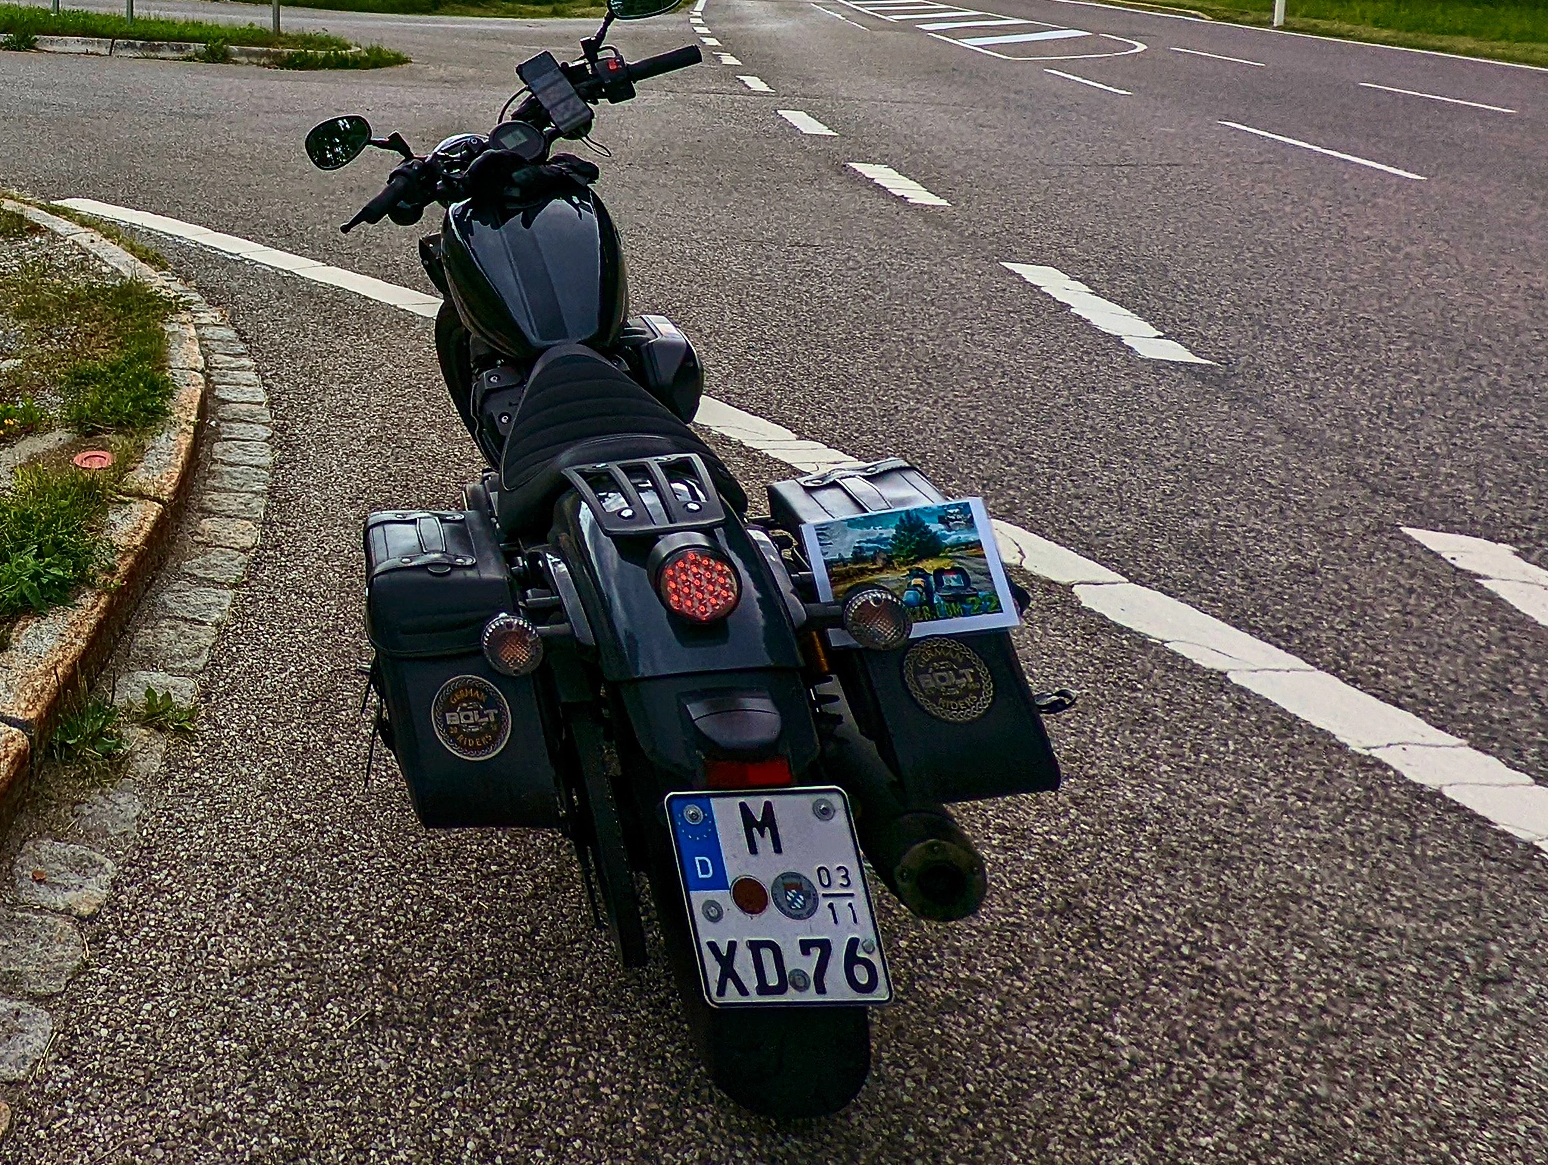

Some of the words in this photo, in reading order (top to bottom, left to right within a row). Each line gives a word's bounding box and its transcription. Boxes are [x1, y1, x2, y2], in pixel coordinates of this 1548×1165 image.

[916, 648, 964, 668] GERMAN
[917, 668, 975, 690] BOLT
[450, 688, 487, 704] GERMAN
[937, 693, 978, 710] RIDERS
[445, 709, 498, 725] BOLT
[456, 734, 492, 747] RIDERS
[738, 800, 783, 855] M
[694, 856, 713, 879] D
[817, 865, 852, 888] 03
[827, 902, 858, 925] 11
